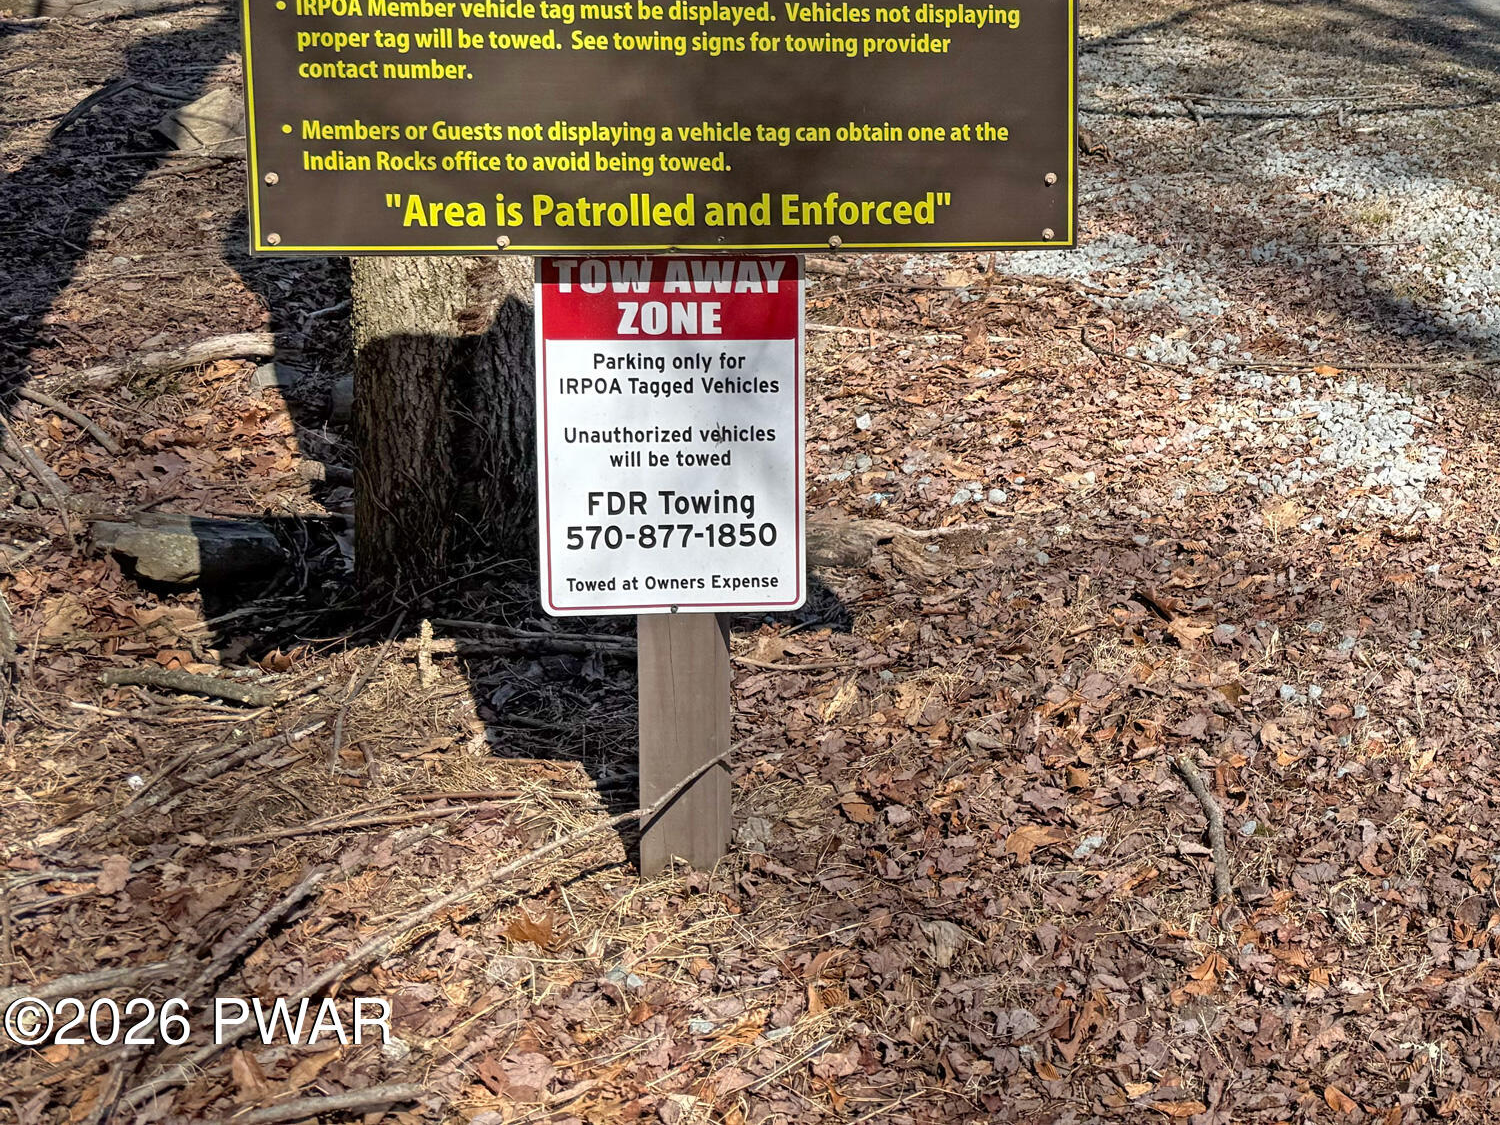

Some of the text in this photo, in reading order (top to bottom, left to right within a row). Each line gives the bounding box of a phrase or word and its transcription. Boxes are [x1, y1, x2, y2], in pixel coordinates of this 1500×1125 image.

[539, 1, 575, 24] tag
[580, 2, 632, 19] must
[638, 0, 663, 20] be
[669, 0, 776, 26] displayed.
[785, 3, 870, 22] Vehicles
[876, 6, 910, 23] not
[915, 3, 1020, 29] displaying
[297, 28, 950, 57] proper tag will be towed. See towing signs for towing provider
[299, 59, 472, 79] contact number.
[302, 120, 1008, 146] Members or Guests not displaying a vehicle tag can obtain one at the
[303, 150, 731, 176] Indian Rocks office to avoid being towed.
[386, 192, 951, 227] "Area is Patrolled and Enforced"
[553, 260, 786, 294] TOW AWAY
[617, 301, 722, 335] ZONE
[594, 352, 745, 373] Parking only for
[560, 377, 779, 397] IRPOA Tagged Vehicles
[565, 425, 775, 443] Unauthorized vehicles
[610, 450, 730, 467] will be towed
[589, 490, 754, 519] FDR Towing
[567, 523, 776, 550] 570-877-1850
[567, 575, 778, 591] Towed at Owners Expense
